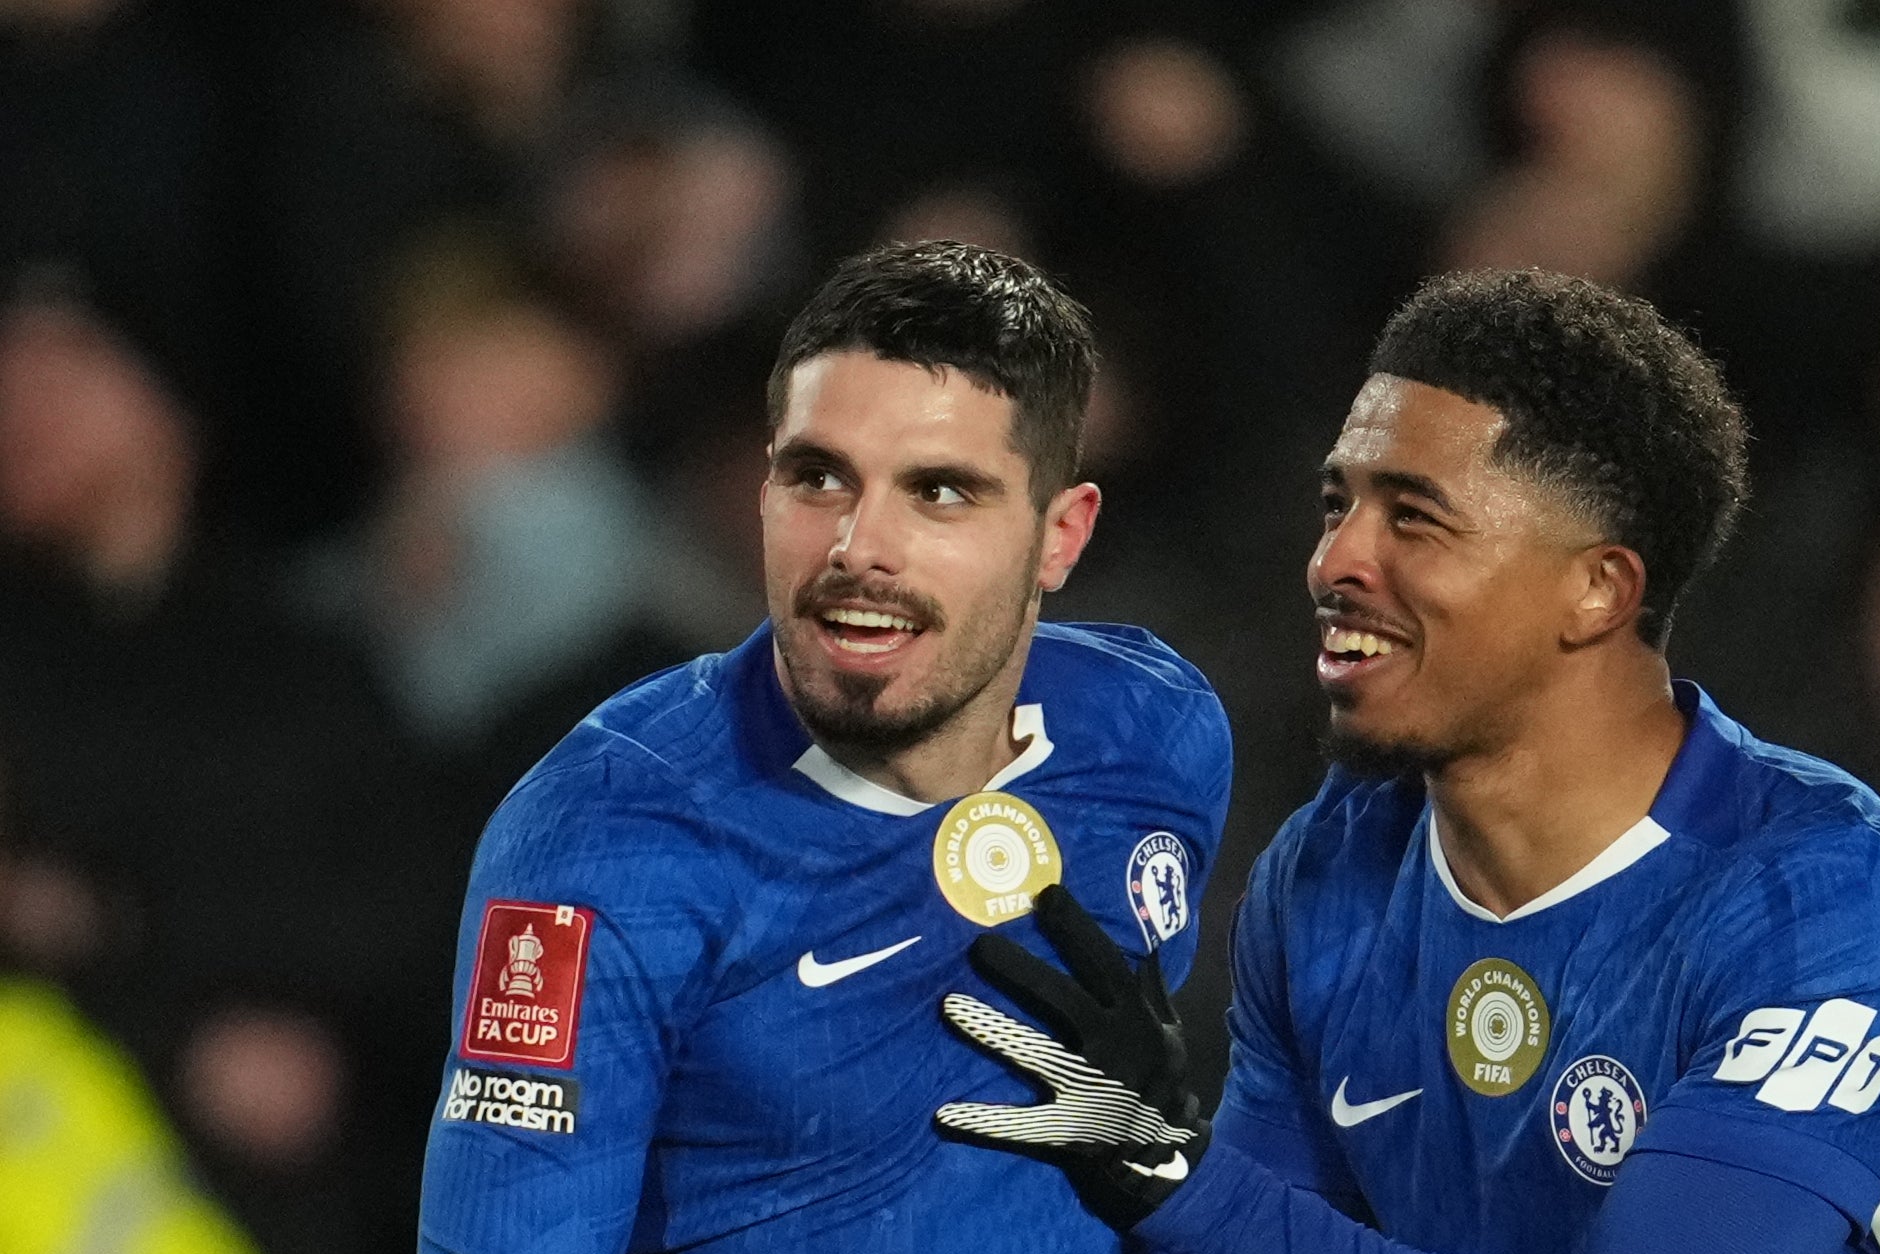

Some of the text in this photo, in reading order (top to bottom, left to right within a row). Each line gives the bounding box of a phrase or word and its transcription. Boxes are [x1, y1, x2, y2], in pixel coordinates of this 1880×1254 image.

[945, 802, 1050, 884] WORLD CHAMPIONS
[1135, 837, 1184, 867] CHELSEA
[984, 892, 1033, 917] FIFA
[480, 998, 560, 1024] Emirates
[1455, 970, 1542, 1048] WORLD CHAMPIONS
[476, 1020, 559, 1047] FA CUP
[451, 1068, 564, 1108] No room
[1473, 1062, 1512, 1086] FIFA
[1566, 1058, 1629, 1088] CHELSEA
[475, 1098, 576, 1135] racism
